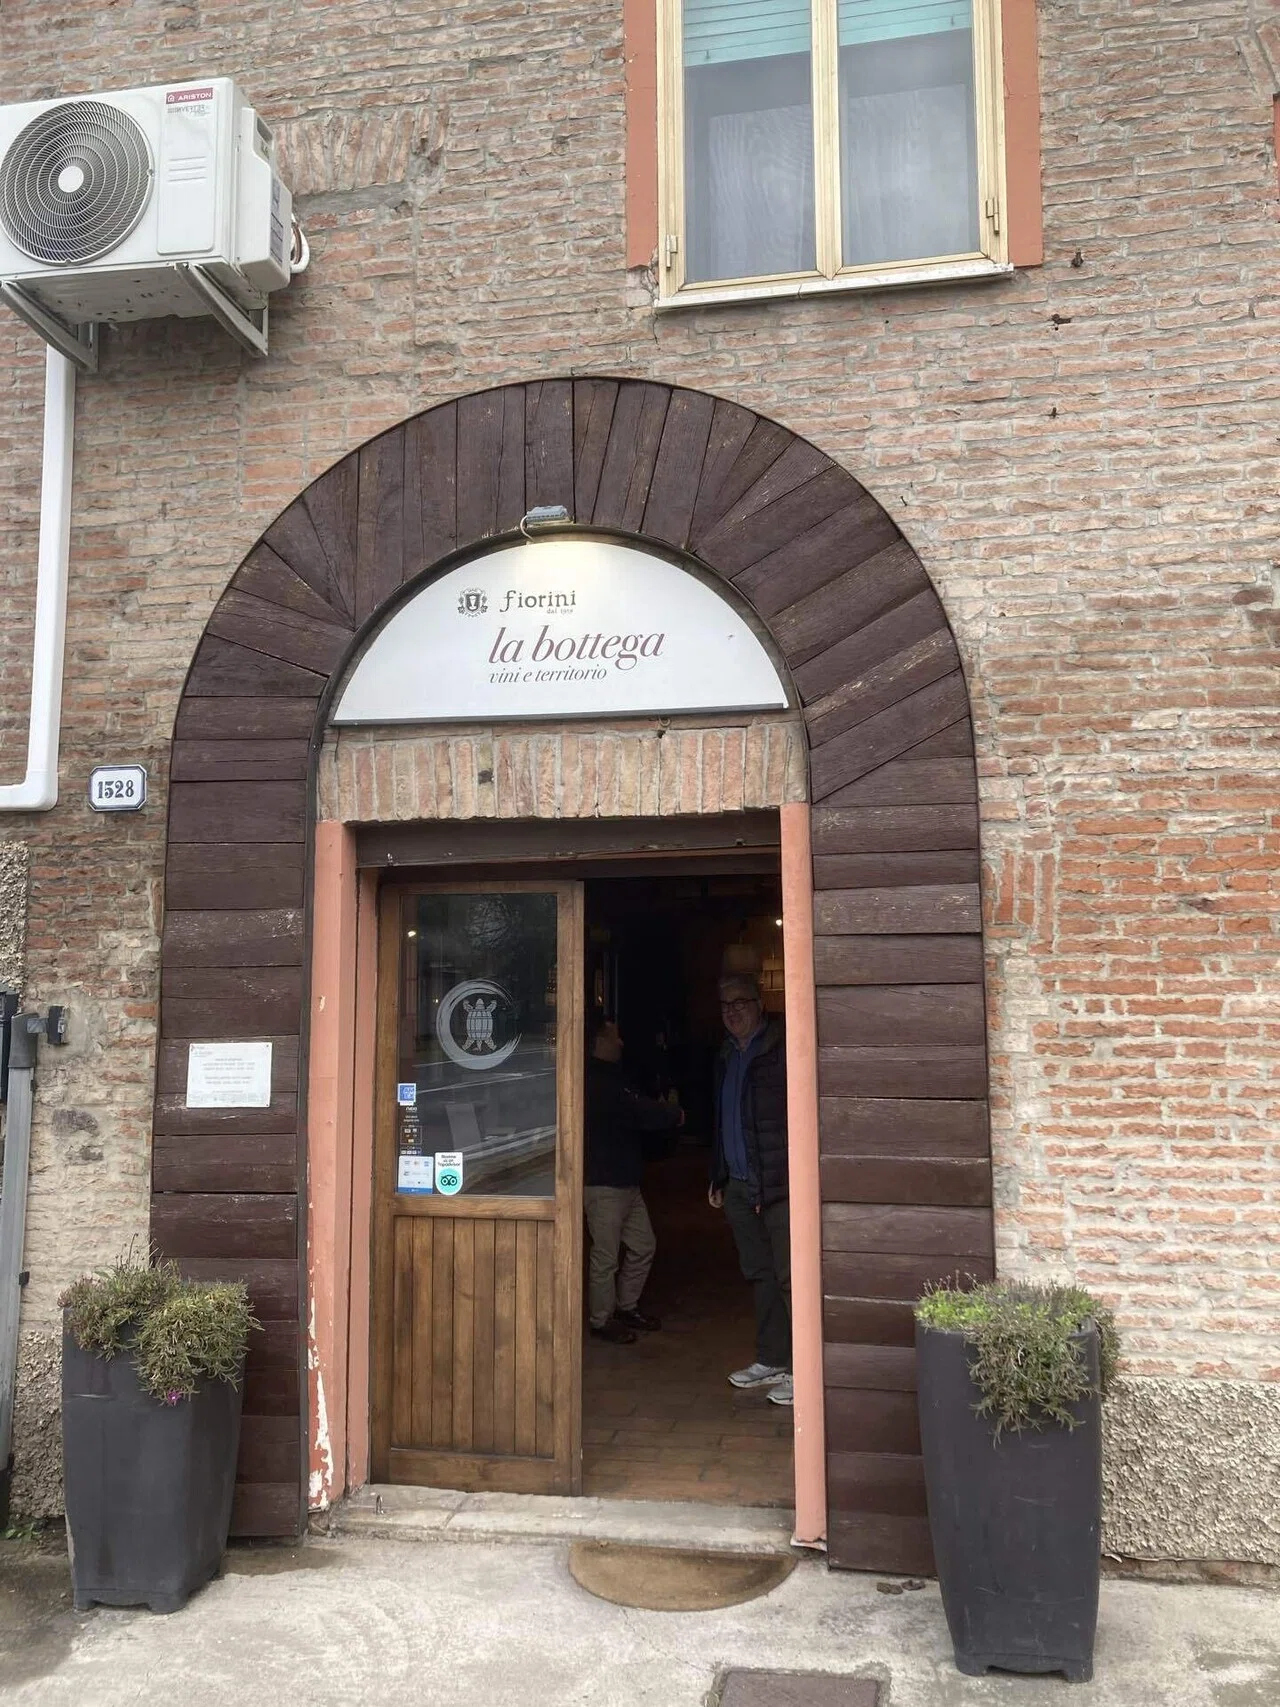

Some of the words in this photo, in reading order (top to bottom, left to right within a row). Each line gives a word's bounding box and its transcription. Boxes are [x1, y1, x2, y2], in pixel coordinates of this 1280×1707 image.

[177, 92, 212, 102] ARISTON
[499, 589, 577, 613] fiorini
[488, 626, 525, 664] la
[531, 624, 665, 671] bottega
[489, 667, 522, 684] vini
[522, 671, 533, 683] e
[534, 663, 608, 682] territorio
[97, 779, 135, 799] 1528
